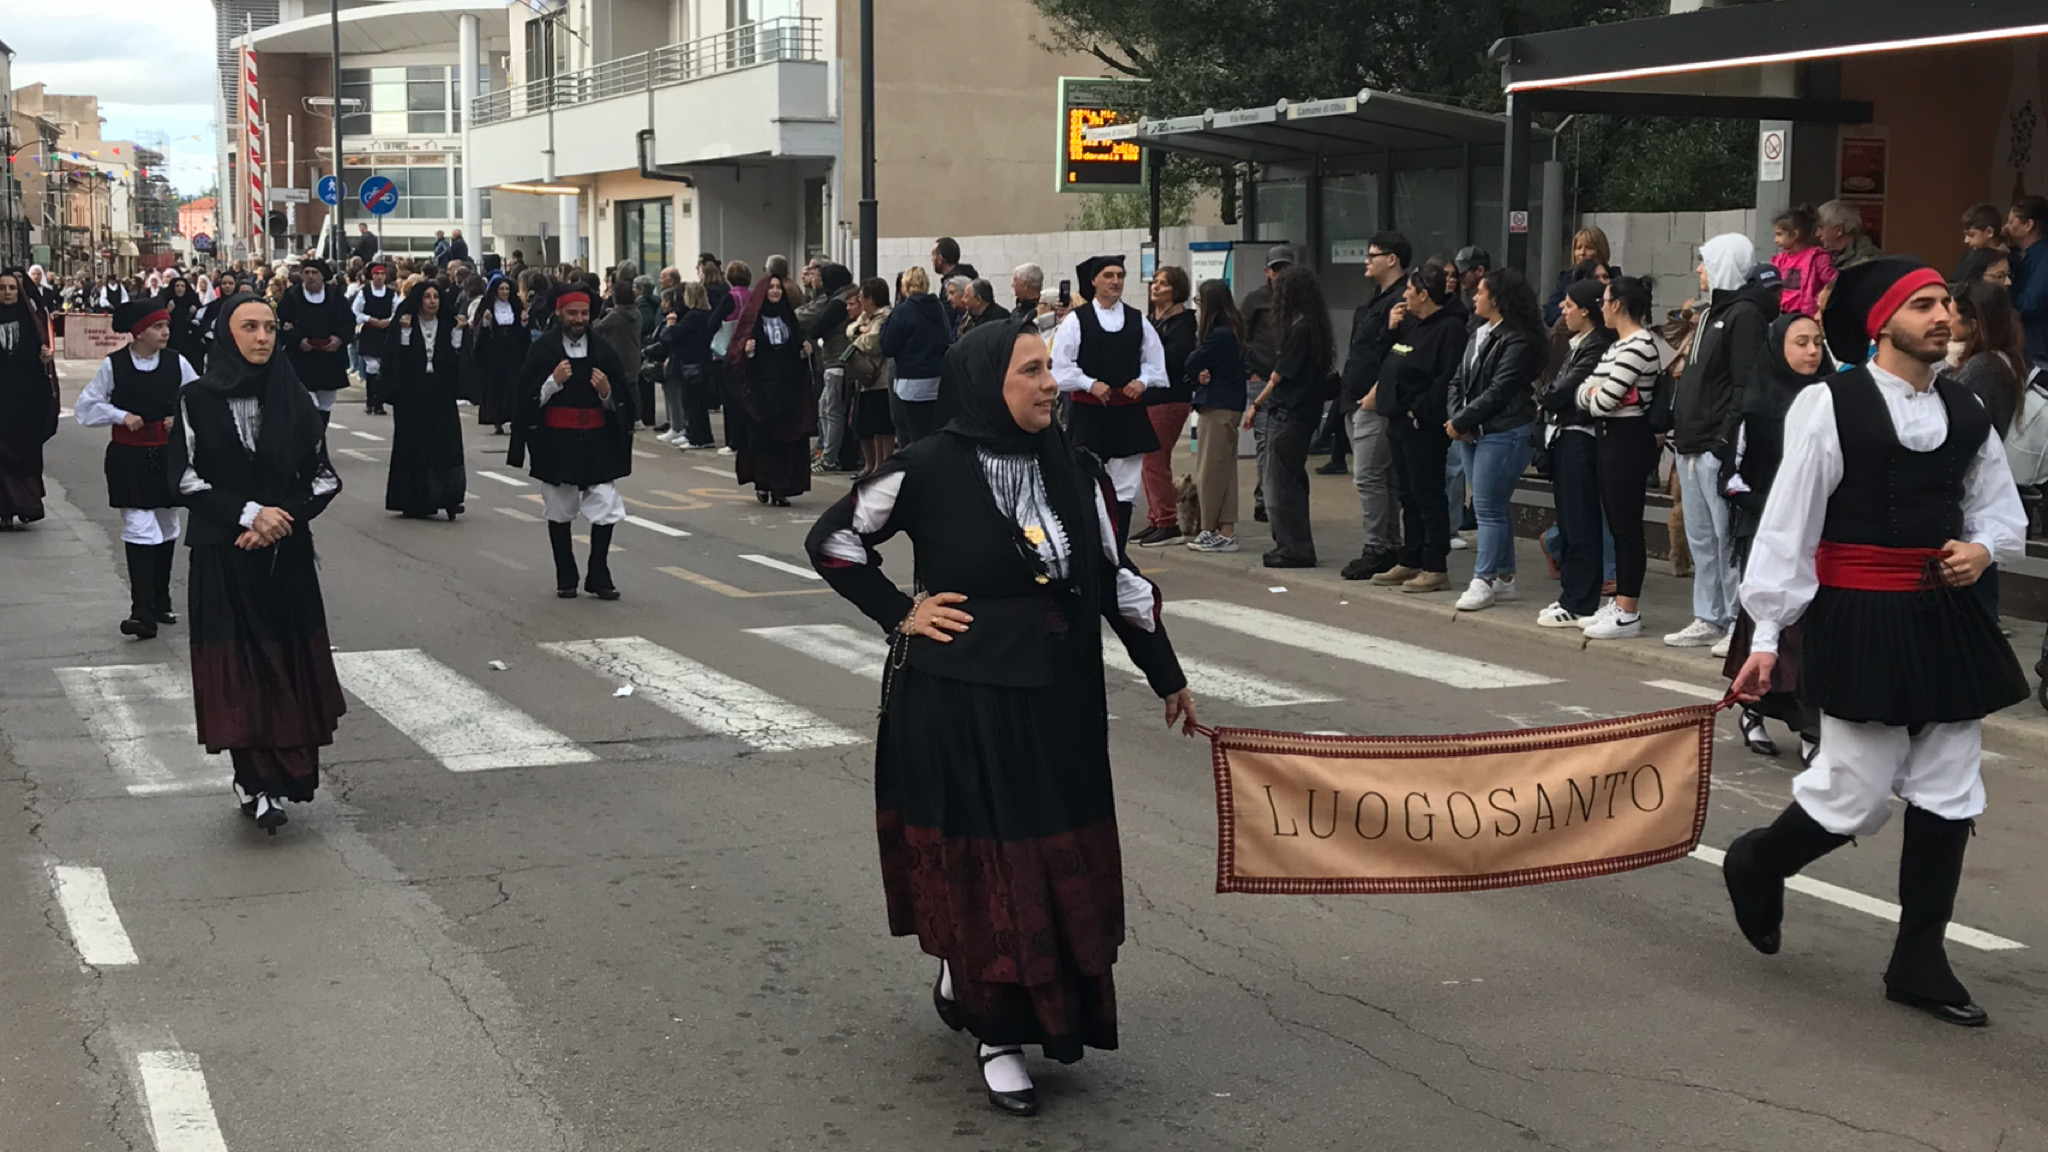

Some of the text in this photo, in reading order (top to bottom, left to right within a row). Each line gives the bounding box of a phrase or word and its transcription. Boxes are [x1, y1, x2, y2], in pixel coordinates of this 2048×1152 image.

[1297, 106, 1322, 116] Comune
[1331, 102, 1346, 112] Olbia
[1263, 764, 1665, 842] LUOGOSANTO
